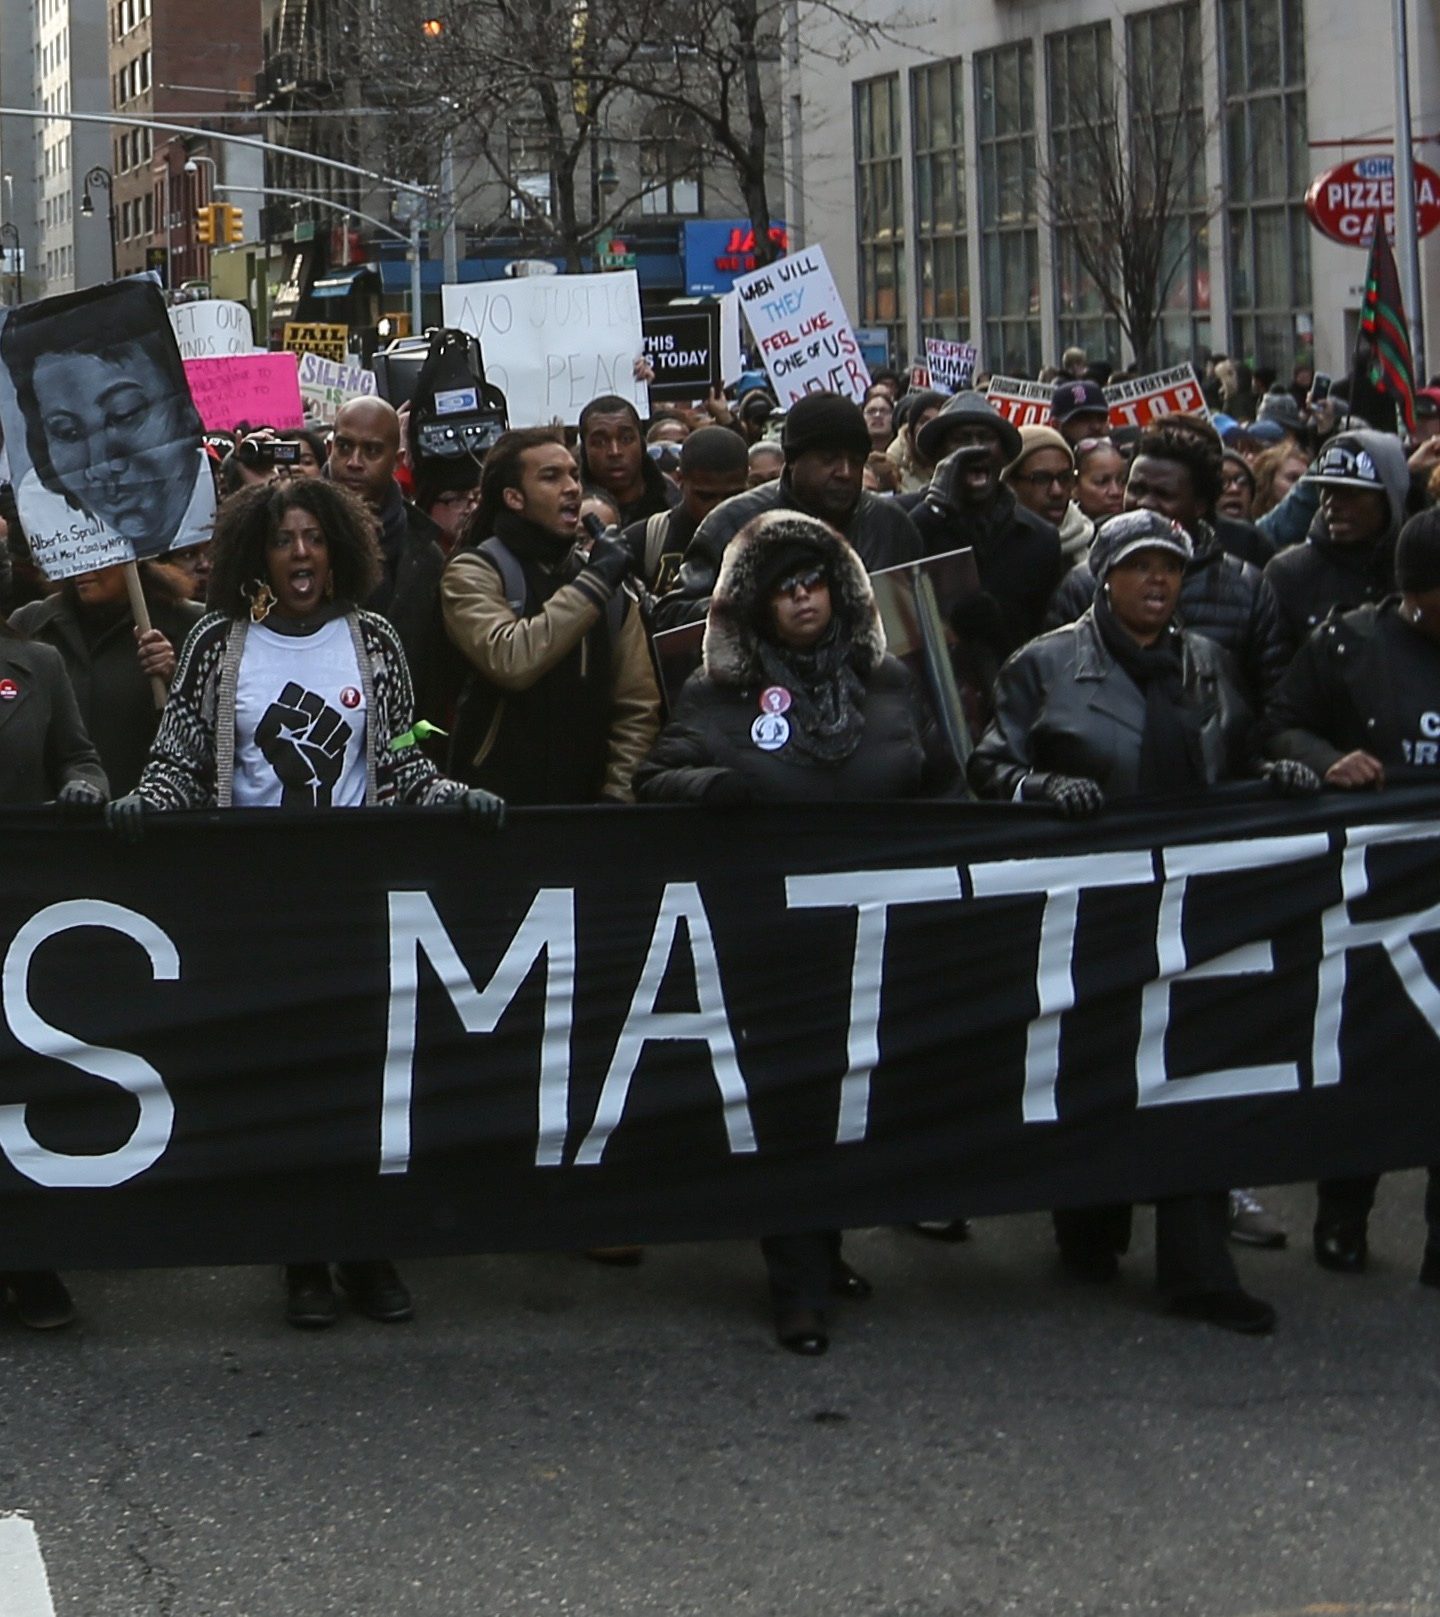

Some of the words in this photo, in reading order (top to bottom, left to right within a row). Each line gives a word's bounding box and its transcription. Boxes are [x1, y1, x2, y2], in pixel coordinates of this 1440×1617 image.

[1328, 178, 1440, 211] PIZZEA,
[739, 274, 775, 302] WHEN
[778, 256, 819, 282] WILL
[457, 292, 513, 339] NO
[761, 285, 805, 323] THEY
[290, 326, 347, 342] JAIL
[761, 329, 800, 356] FEEL
[799, 311, 834, 338] LIKE
[926, 340, 977, 359] RESPECT
[658, 350, 709, 369] TODAY
[773, 352, 808, 378] ONE
[807, 340, 821, 359] OF
[822, 328, 857, 358] US
[300, 354, 374, 395] SILENC
[326, 387, 343, 405] IS
[1118, 389, 1195, 426] TOP
[30, 530, 69, 552] Alberta
